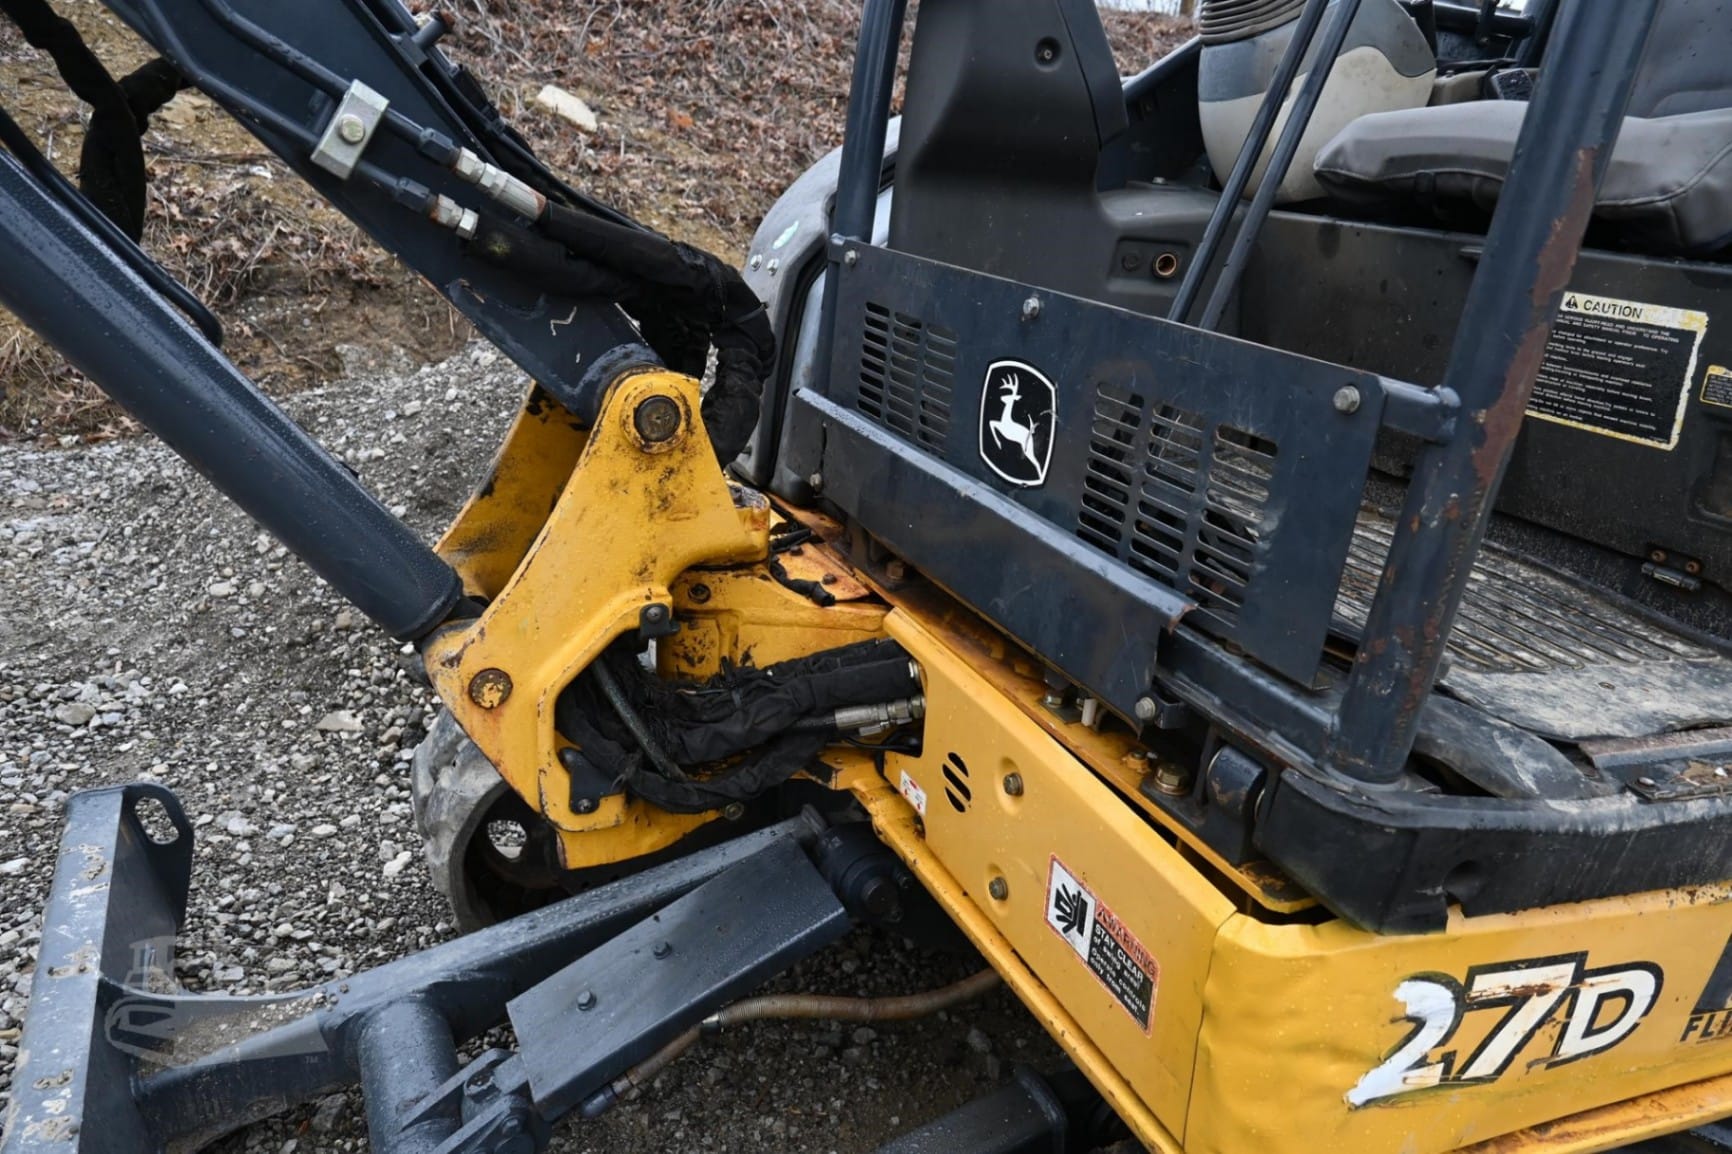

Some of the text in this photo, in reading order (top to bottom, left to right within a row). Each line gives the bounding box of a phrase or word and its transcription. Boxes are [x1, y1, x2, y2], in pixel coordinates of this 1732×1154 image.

[1583, 299, 1643, 319] CAUTION
[1095, 923, 1143, 983] STAY CLEAR
[1118, 975, 1146, 1013] controls
[1341, 951, 1664, 1109] 27D
[1680, 1011, 1732, 1042] FLI
